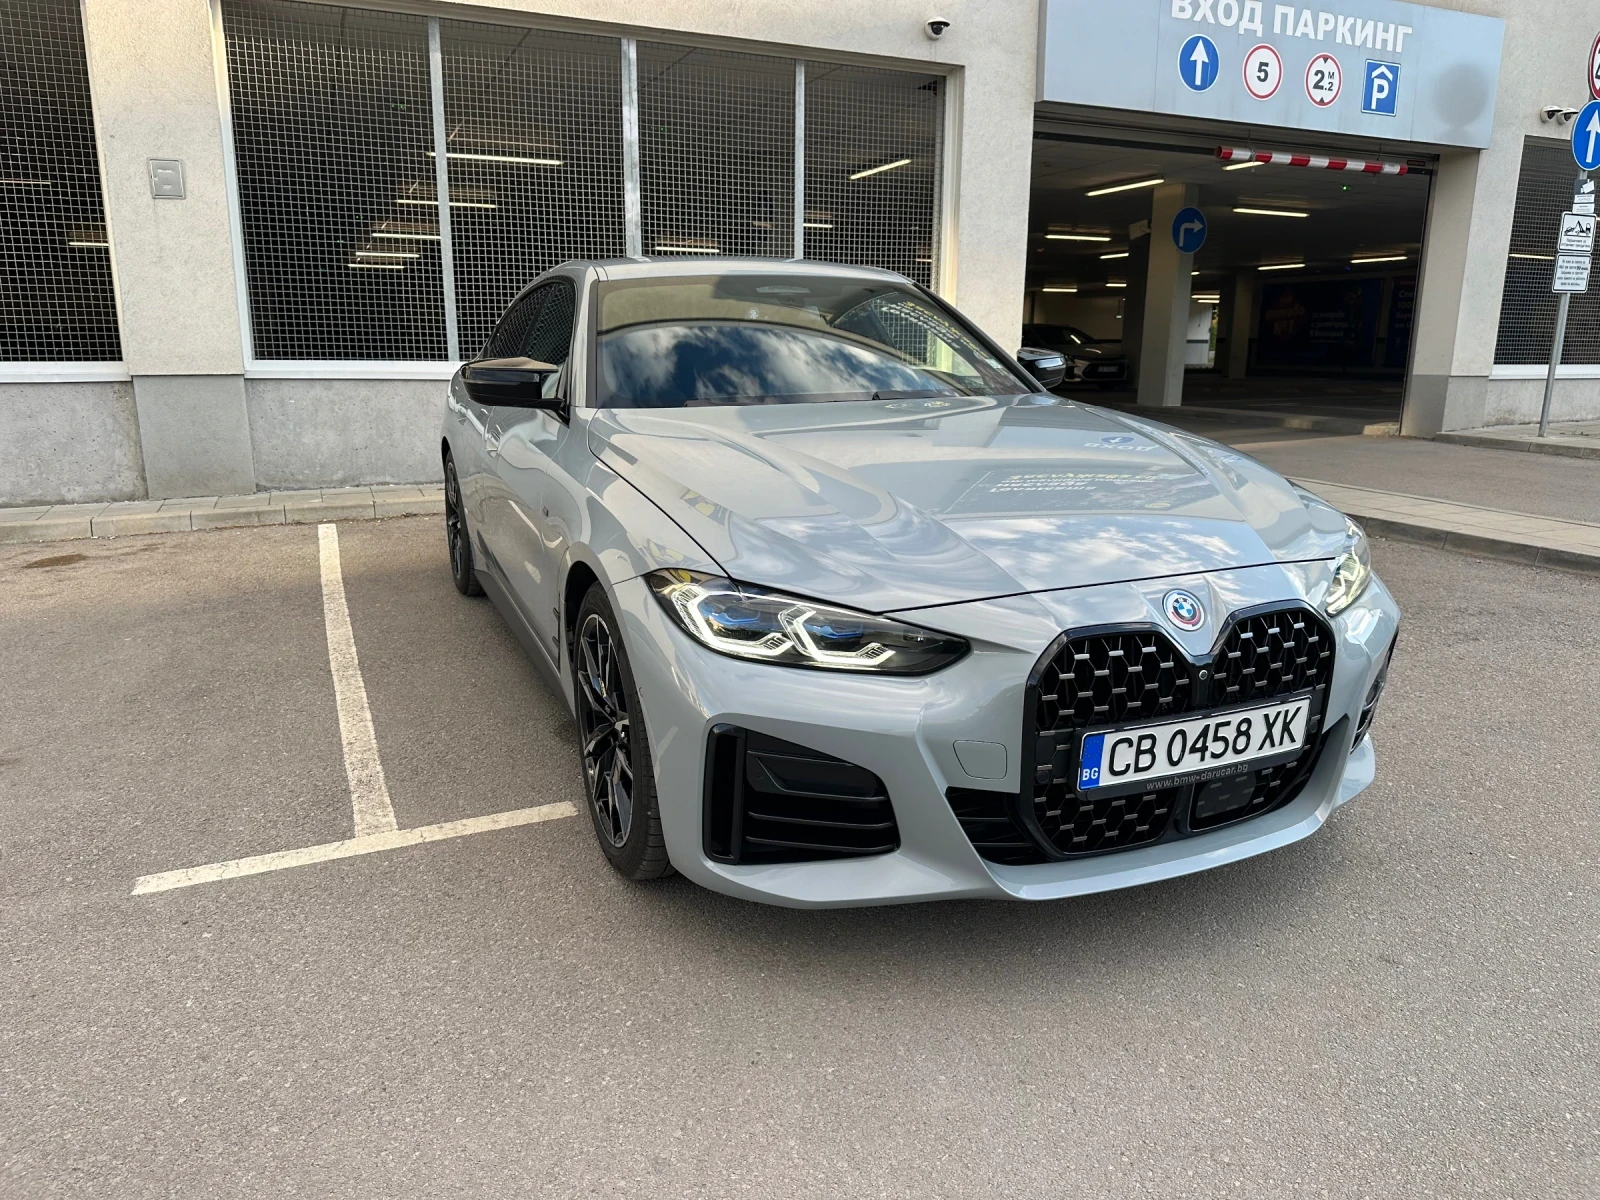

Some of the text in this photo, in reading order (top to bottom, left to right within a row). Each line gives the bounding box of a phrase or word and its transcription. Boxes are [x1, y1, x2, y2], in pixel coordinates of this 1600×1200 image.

[1171, 0, 1413, 53] ВХОД ПАРКИНГ
[1256, 61, 1270, 84] 5
[1372, 78, 1389, 110] P
[1108, 705, 1303, 777] CB 0458 XK
[1081, 766, 1099, 781] BG
[1145, 762, 1249, 791] www.bmw-darucar.bg
